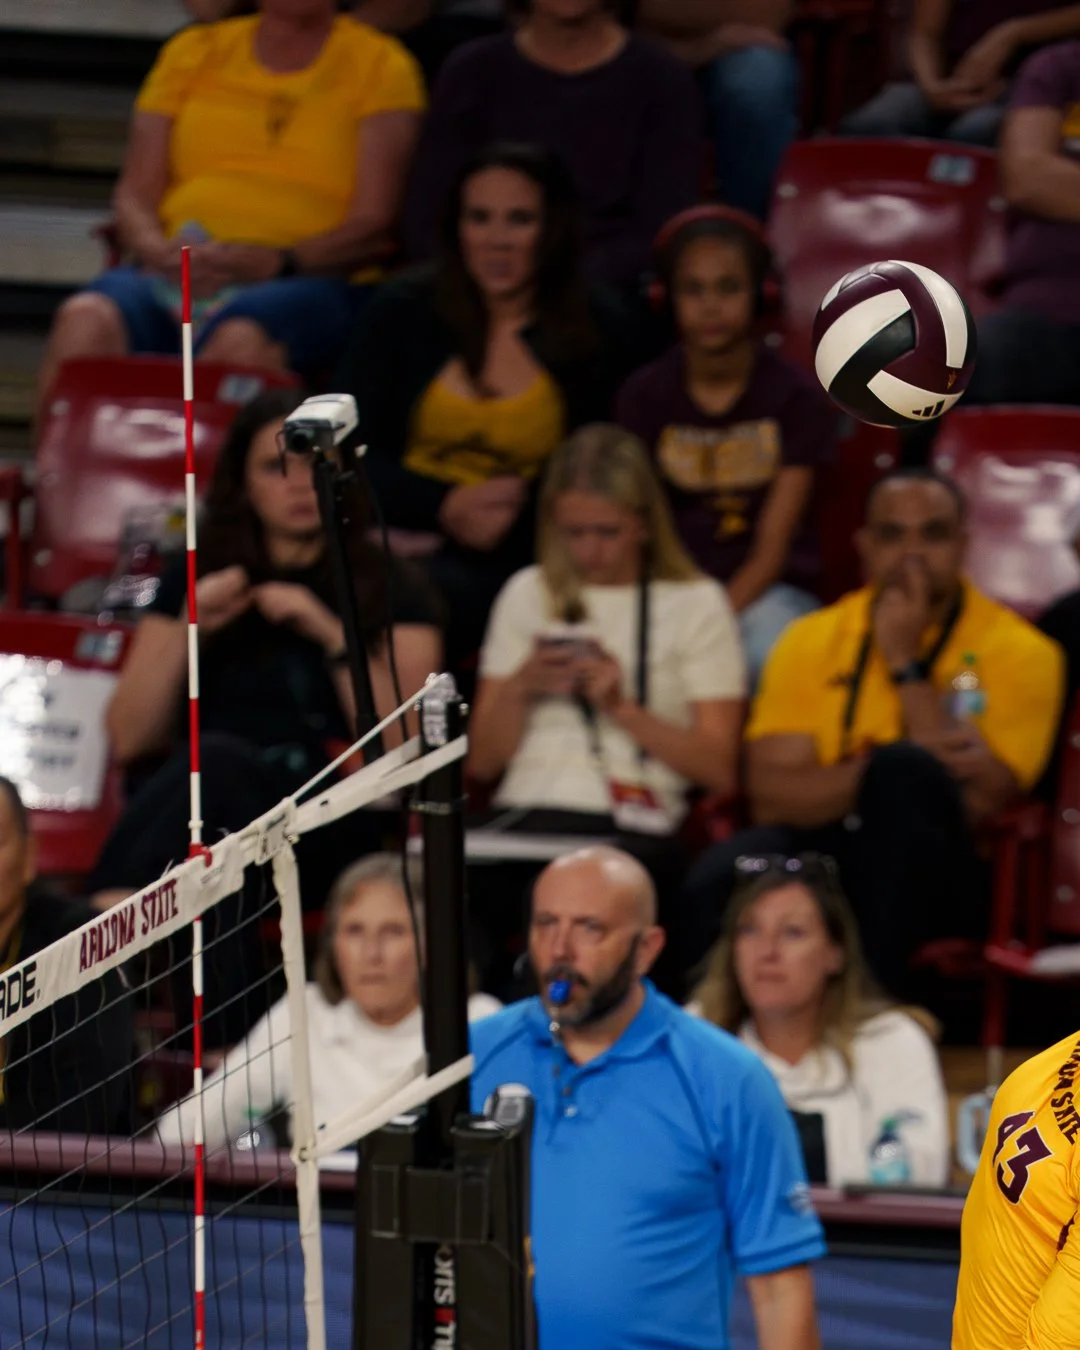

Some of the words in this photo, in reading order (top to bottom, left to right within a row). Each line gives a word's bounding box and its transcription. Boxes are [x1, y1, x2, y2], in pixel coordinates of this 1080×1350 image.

[79, 903, 136, 973] ARIZONA
[141, 879, 179, 936] STATE
[992, 1111, 1054, 1205] 43
